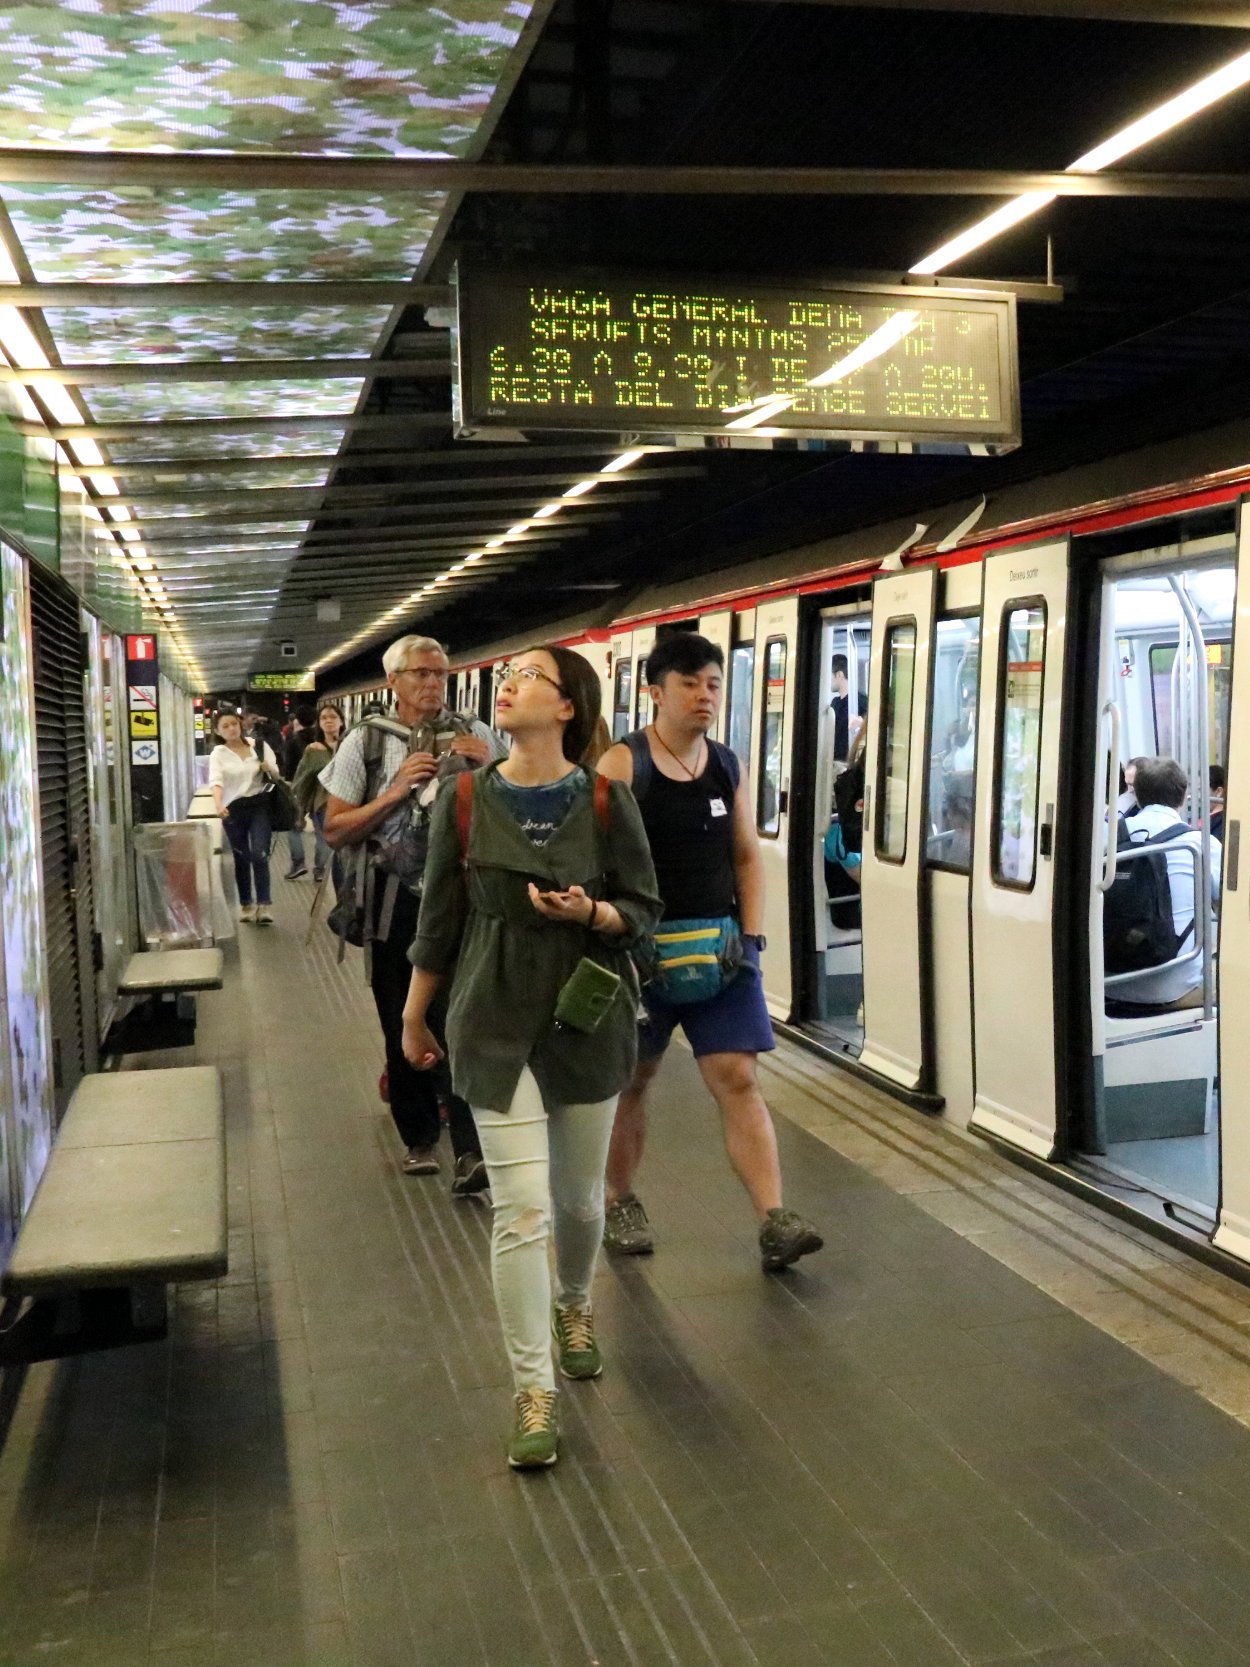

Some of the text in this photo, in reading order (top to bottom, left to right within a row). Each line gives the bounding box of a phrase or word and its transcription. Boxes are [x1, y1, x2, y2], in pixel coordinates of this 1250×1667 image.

[530, 288, 612, 316] VAGA
[771, 357, 809, 384] DE
[489, 376, 594, 405] RESTA
[614, 380, 674, 408] DEL
[886, 391, 990, 419] SERVEI
